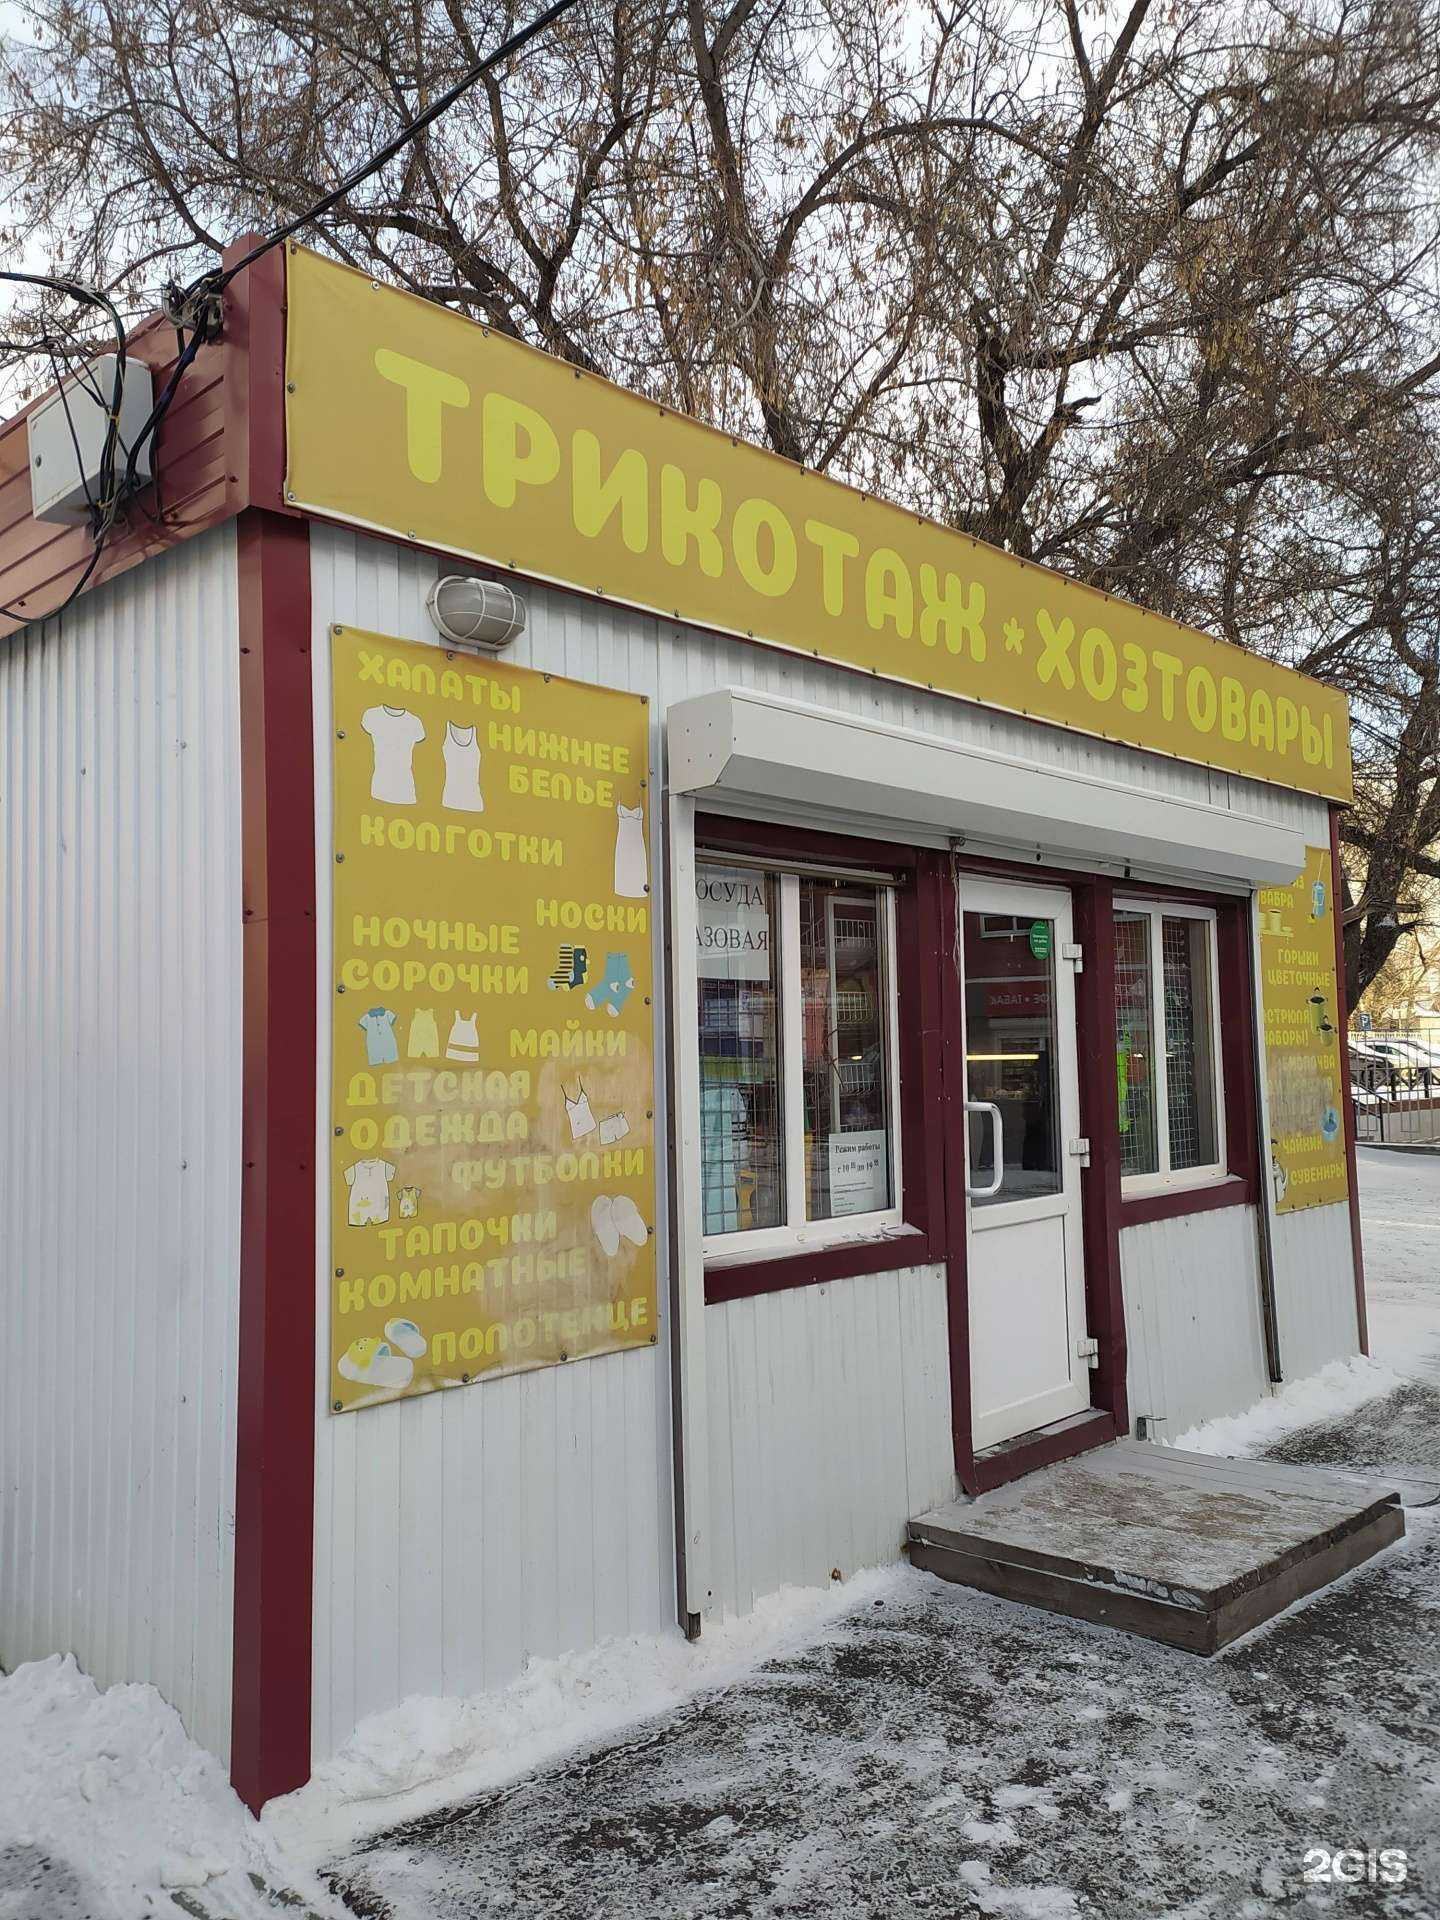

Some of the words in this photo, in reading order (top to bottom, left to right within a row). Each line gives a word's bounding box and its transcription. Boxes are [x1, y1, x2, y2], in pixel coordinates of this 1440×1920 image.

[374, 348, 986, 662] ТРИКОТАЖ
[1036, 608, 1333, 769] ХОЗТОВАРЫ
[358, 651, 520, 713] ХАЛАТЫ
[488, 720, 630, 774] НИЖНЕЕ
[508, 764, 614, 808] БЕЛЬЕ
[360, 814, 563, 867] КОЛГОТКИ
[536, 898, 647, 933] НОСКИ
[1258, 889, 1294, 909] ВАБРА
[353, 914, 520, 954] НОЧНЫЕ
[342, 958, 528, 994] СОРОЧКИ
[1268, 969, 1330, 987] ЦВЕТОЧНЫЕ
[1264, 1008, 1310, 1024] СТРЮЛЯ
[509, 1019, 626, 1058] МАЙКИ
[346, 1070, 530, 1106] ДЕТСКАЯ
[349, 1110, 529, 1150] ОДЕЖДА
[451, 1149, 644, 1190] ФУТБОЛКИ
[1291, 1163, 1345, 1185] СУВЕНИРЫ
[378, 1209, 557, 1260] ТАПОЧКИ
[339, 1246, 587, 1314] КОМНАТНЫЕ
[432, 1297, 648, 1365] ПОЛОТЕНЦЕ
